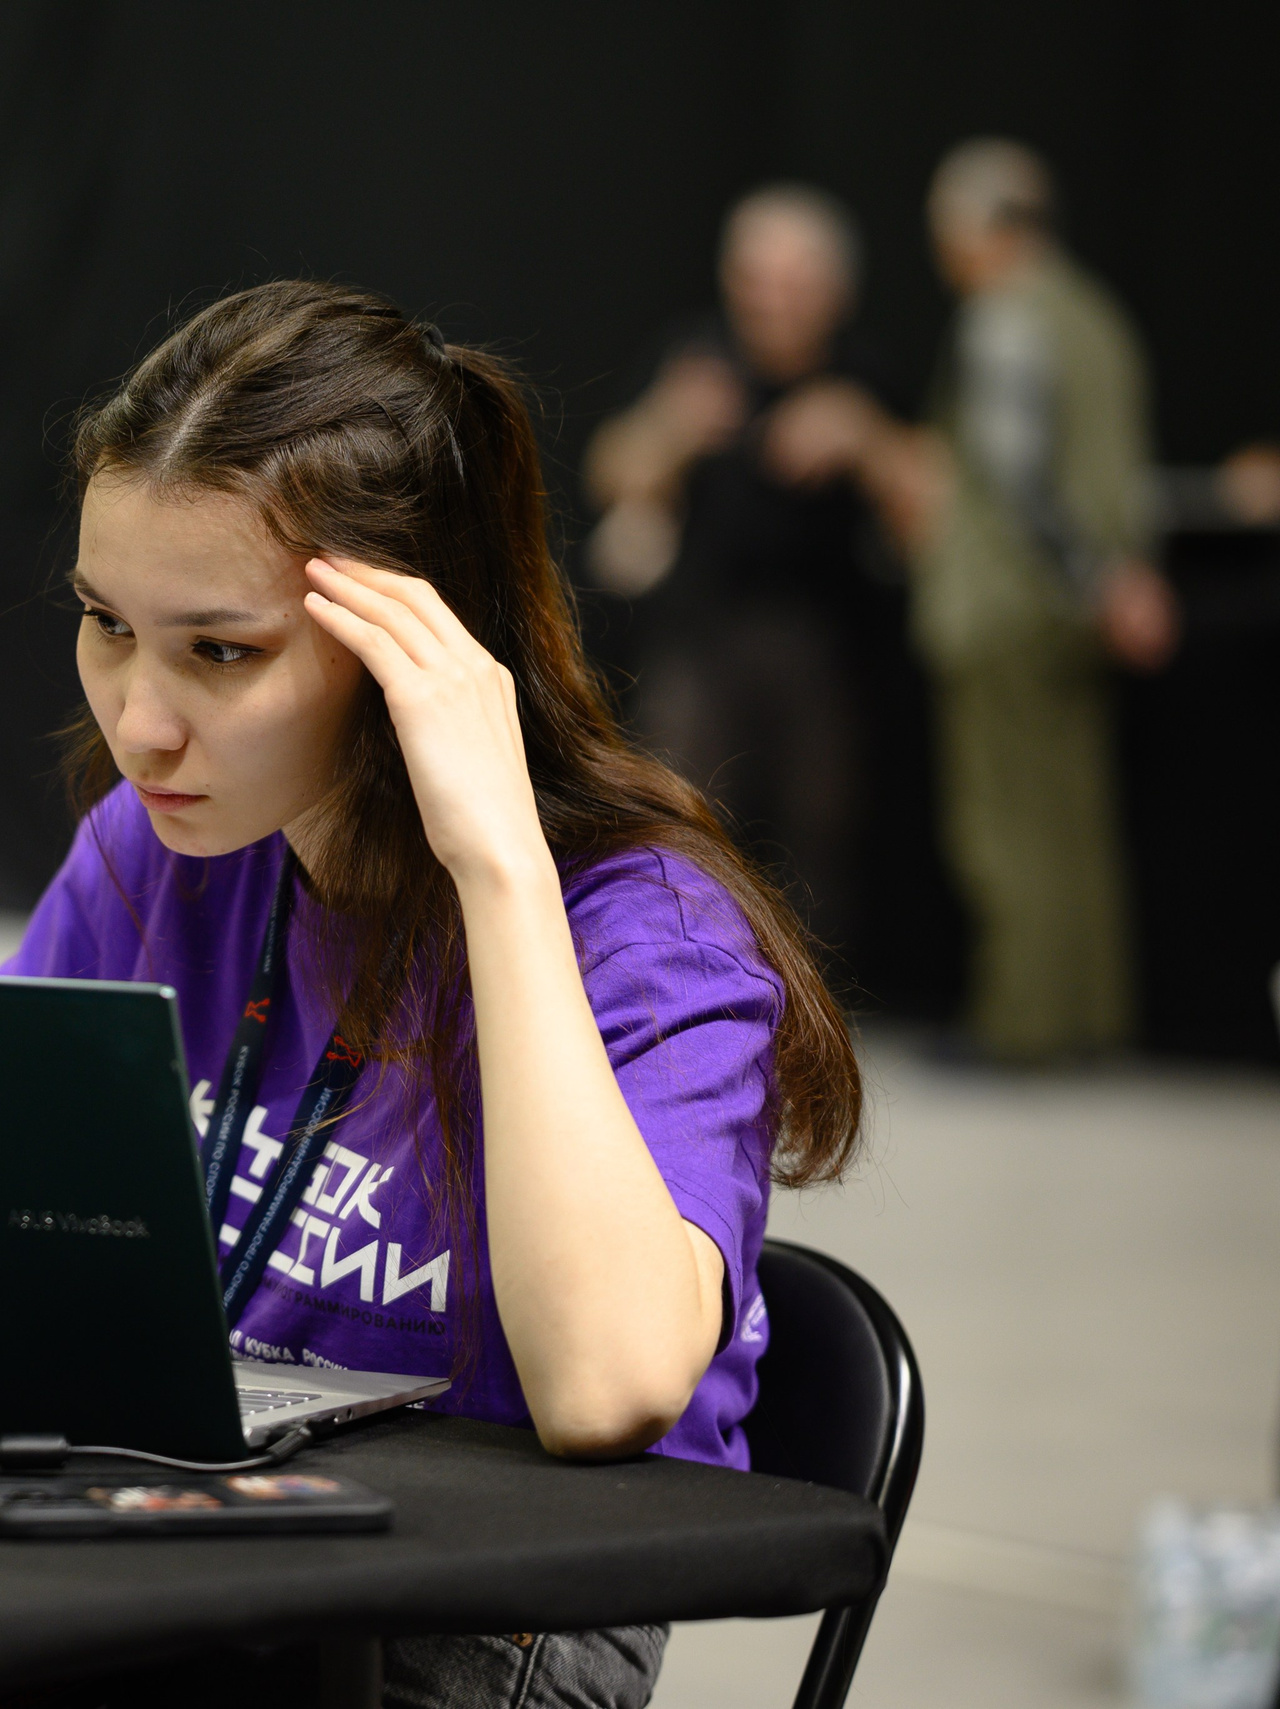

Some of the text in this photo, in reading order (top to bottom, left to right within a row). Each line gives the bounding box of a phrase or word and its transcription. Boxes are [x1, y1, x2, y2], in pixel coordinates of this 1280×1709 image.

[232, 1045, 249, 1087] КУБОК
[218, 1088, 240, 1141] РОССИИ
[211, 1141, 227, 1160] ПО
[244, 1136, 311, 1261] ПРОГРАММИРОВАНИЯ
[304, 1087, 333, 1137] РОССИИ
[273, 1279, 447, 1337] ОГРАММИРОВАНИЮ
[244, 1335, 295, 1361] КУБКА
